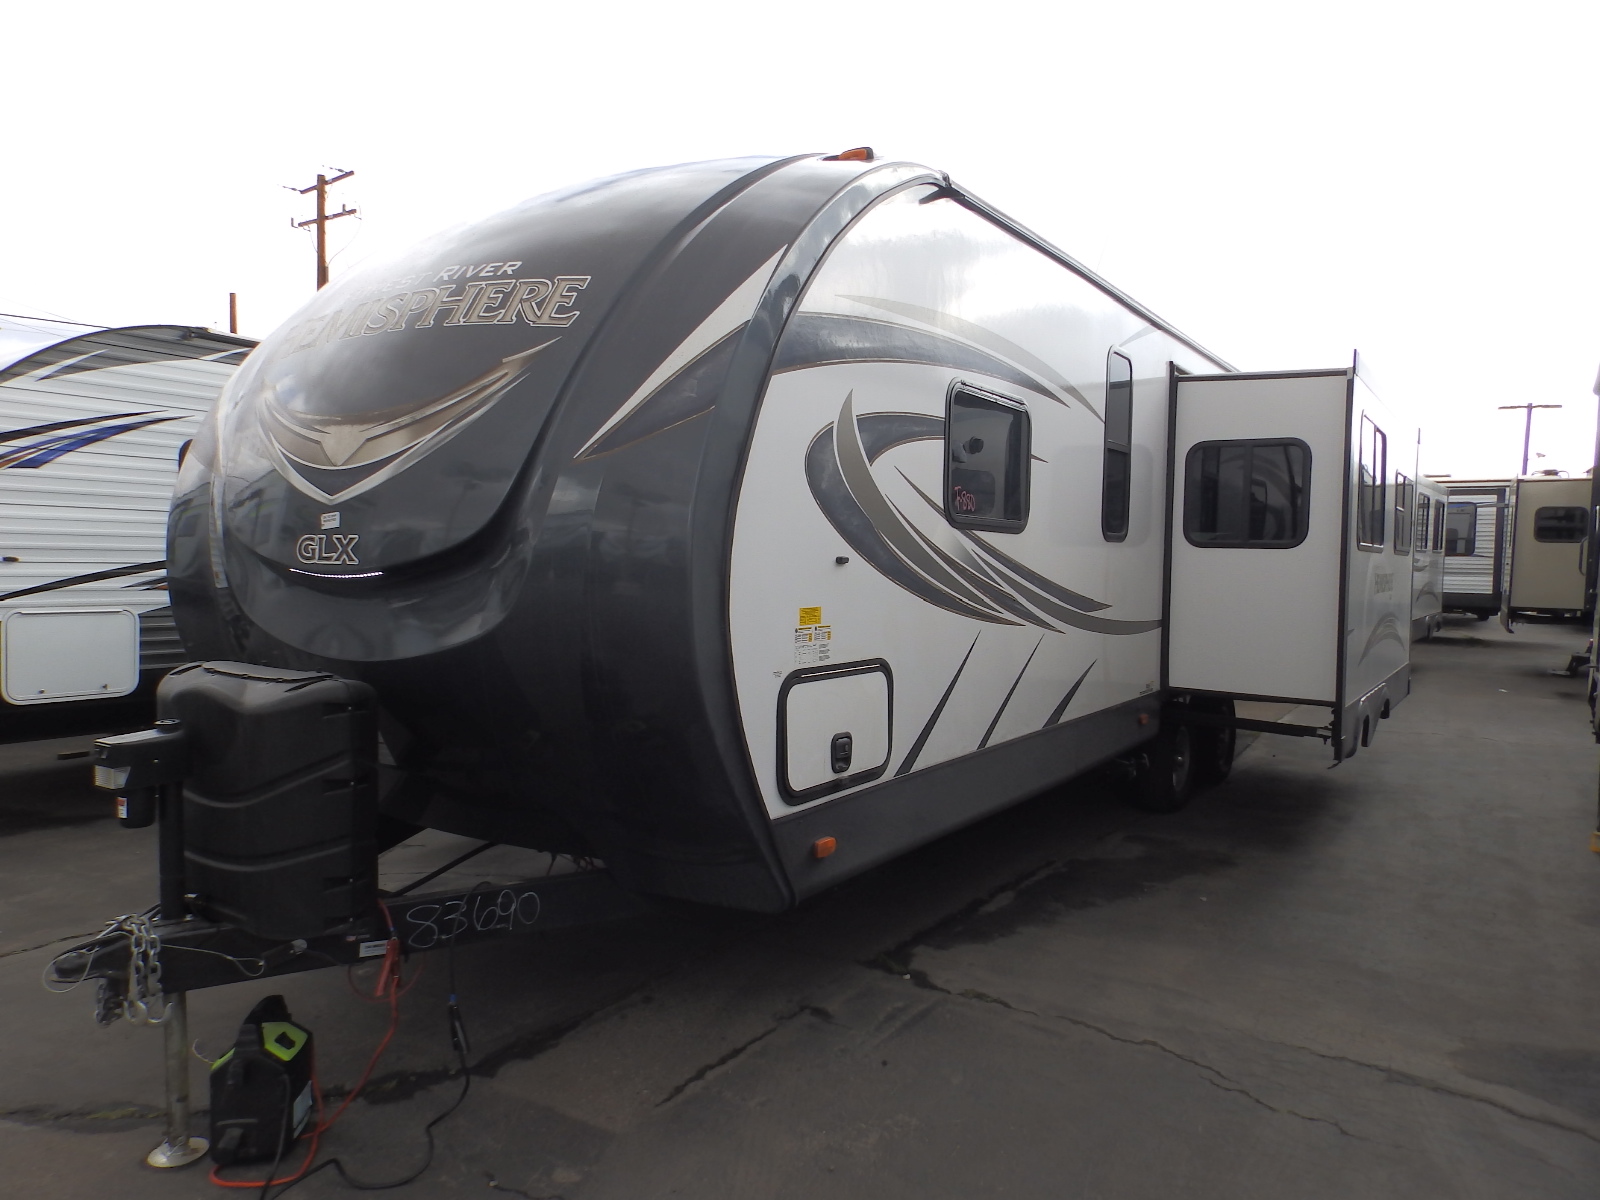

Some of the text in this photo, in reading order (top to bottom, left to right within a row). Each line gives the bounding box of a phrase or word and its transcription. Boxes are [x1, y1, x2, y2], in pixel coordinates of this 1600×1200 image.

[433, 261, 522, 282] RIVER
[296, 534, 359, 565] GLX
[406, 889, 540, 948] 83690
